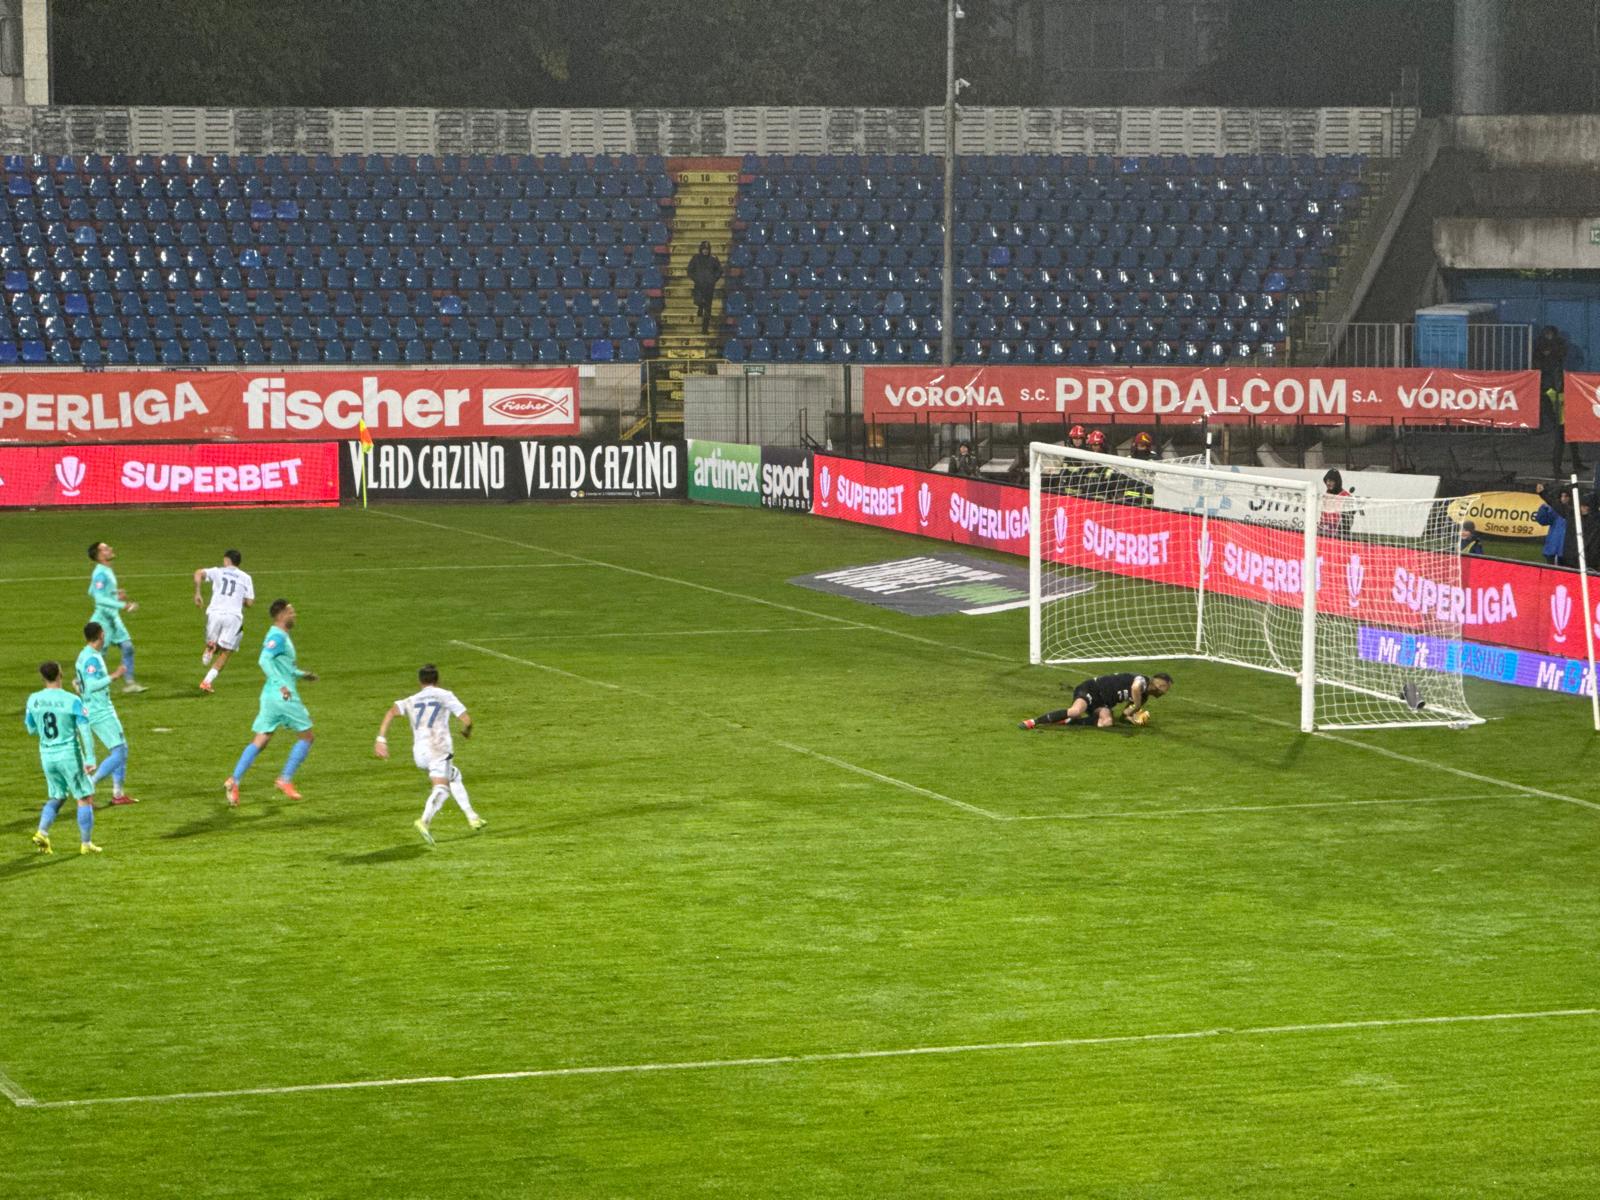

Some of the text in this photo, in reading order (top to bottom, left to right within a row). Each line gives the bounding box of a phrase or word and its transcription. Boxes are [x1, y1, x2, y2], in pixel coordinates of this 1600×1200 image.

[243, 377, 470, 429] fischer
[501, 400, 550, 411] fischer
[885, 384, 1004, 406] VORONA
[1020, 378, 1382, 414] S.C. PRODALCOM S.A.
[1397, 385, 1518, 411] VORONA
[121, 458, 302, 492] SUPERBET
[348, 441, 505, 498] VLAD CAZINO
[520, 441, 677, 498] VLAD CAZINO
[694, 448, 810, 498] artimex sport
[762, 496, 811, 510] equipment
[836, 475, 904, 516] SUPERBET
[950, 492, 1030, 540] SUPERLIGA
[1484, 522, 1534, 535] Since 1992
[1082, 518, 1170, 566] SUPERBET
[221, 577, 236, 596] 11
[1392, 567, 1518, 624] SUPERLIGA
[43, 711, 58, 739] 8
[414, 702, 442, 730] 77
